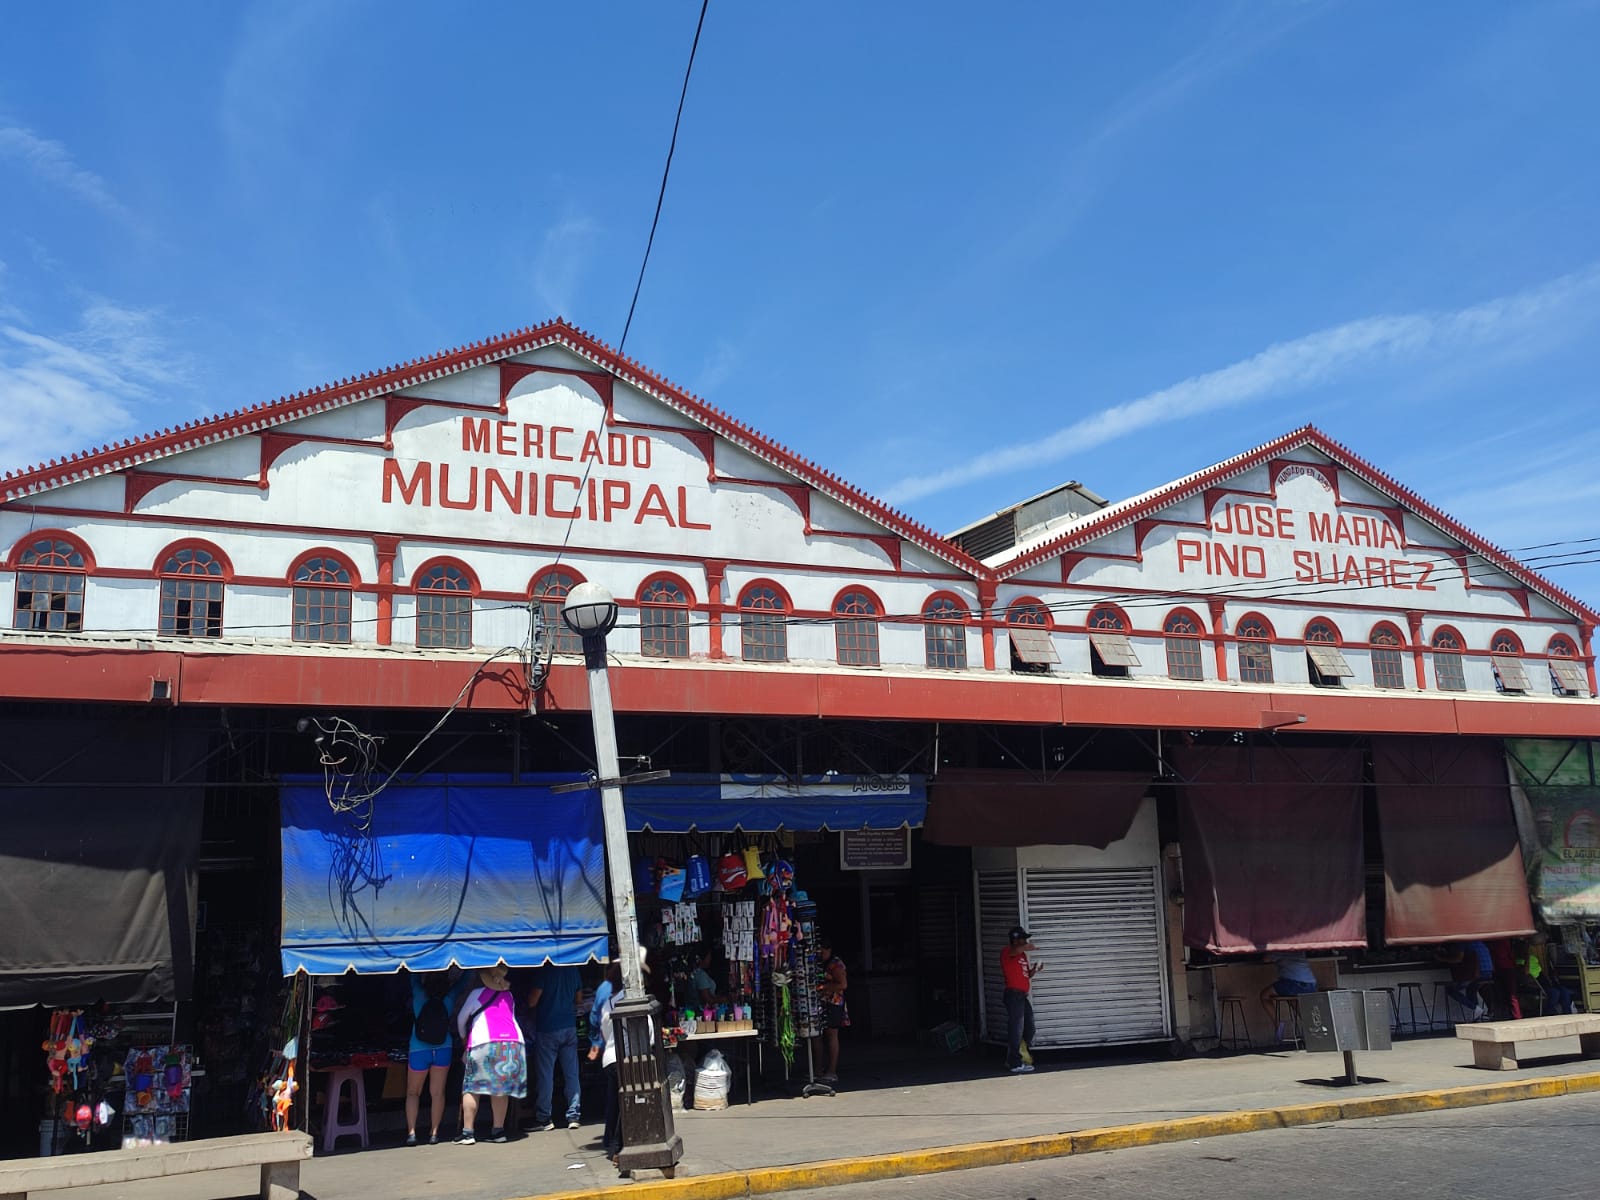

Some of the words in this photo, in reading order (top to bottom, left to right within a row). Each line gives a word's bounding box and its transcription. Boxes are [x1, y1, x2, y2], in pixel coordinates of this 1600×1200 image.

[462, 416, 651, 469] MERCADO
[382, 457, 712, 531] MUNICIPAL
[1278, 467, 1304, 485] FUNDADO
[1214, 502, 1296, 540] JOSE
[1308, 511, 1401, 550] MARIA
[1176, 539, 1267, 579] PINO
[1293, 550, 1437, 592] SUAREZ
